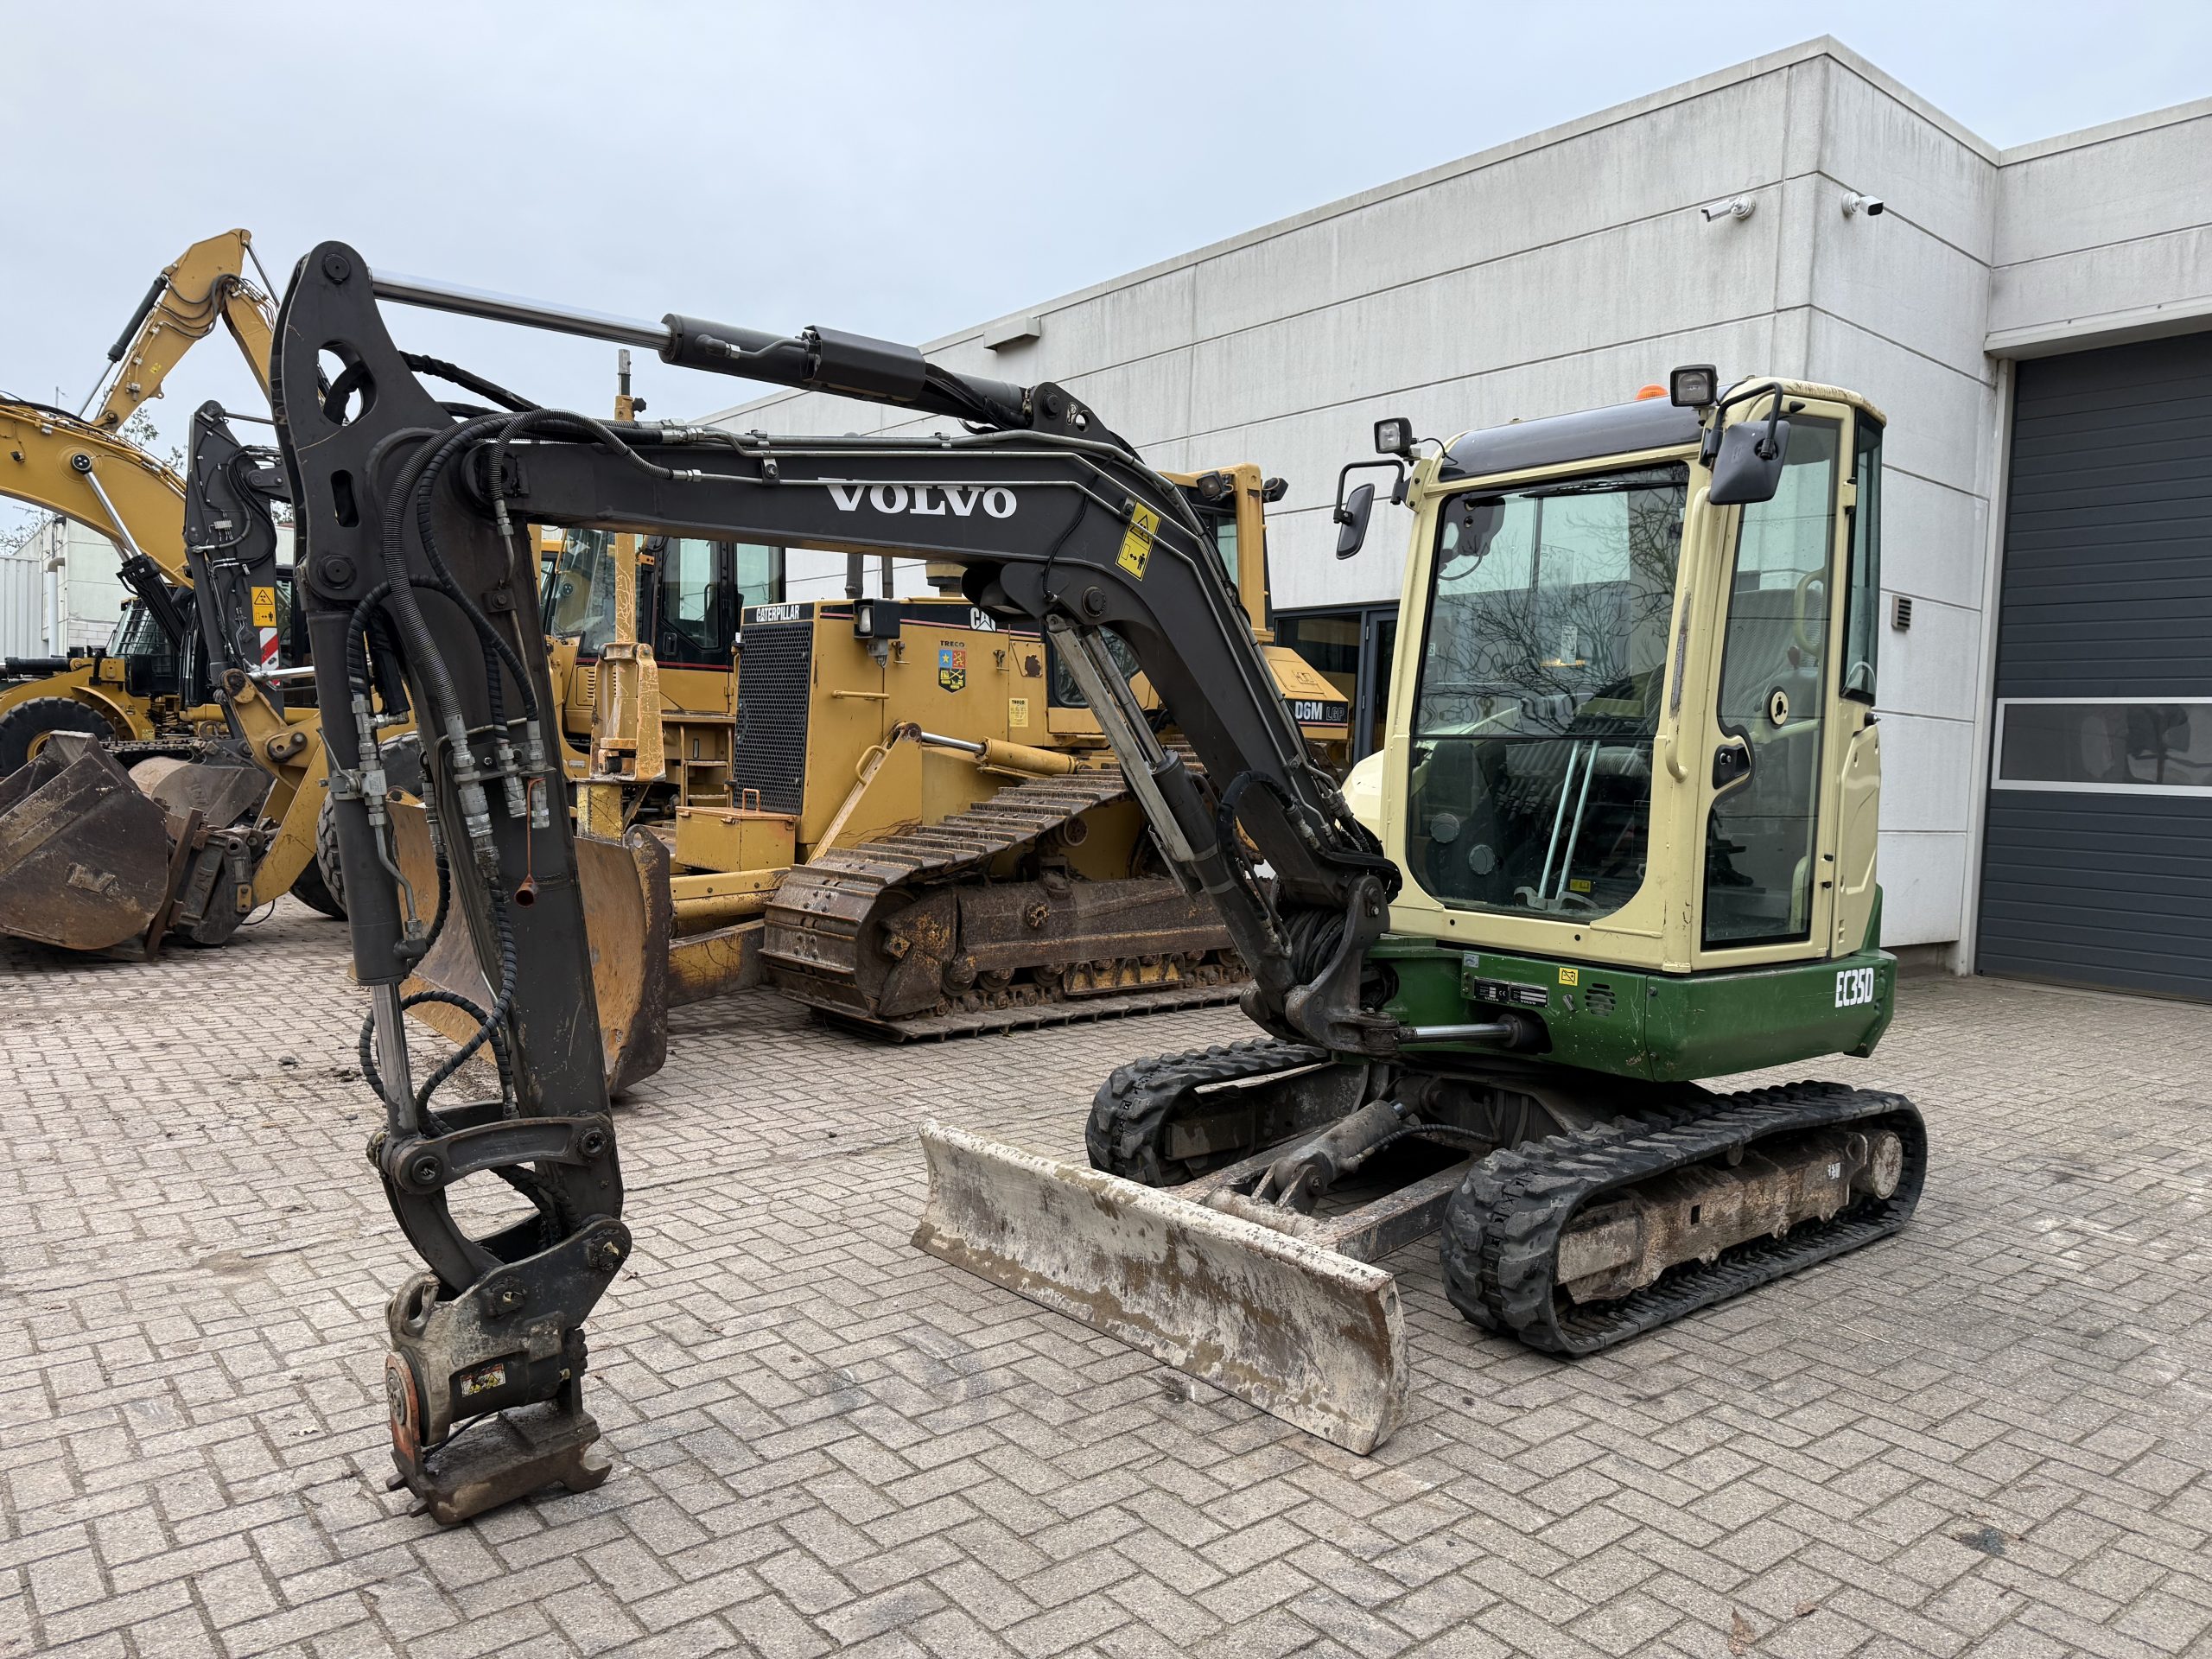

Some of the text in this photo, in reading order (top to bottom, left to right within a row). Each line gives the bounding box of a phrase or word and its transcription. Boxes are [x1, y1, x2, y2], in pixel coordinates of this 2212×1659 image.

[818, 476, 1017, 518] VOLVO
[756, 605, 800, 622] CATERPILLAR
[1294, 701, 1344, 721] D6M LGP
[1834, 967, 1874, 1008] EC35D
